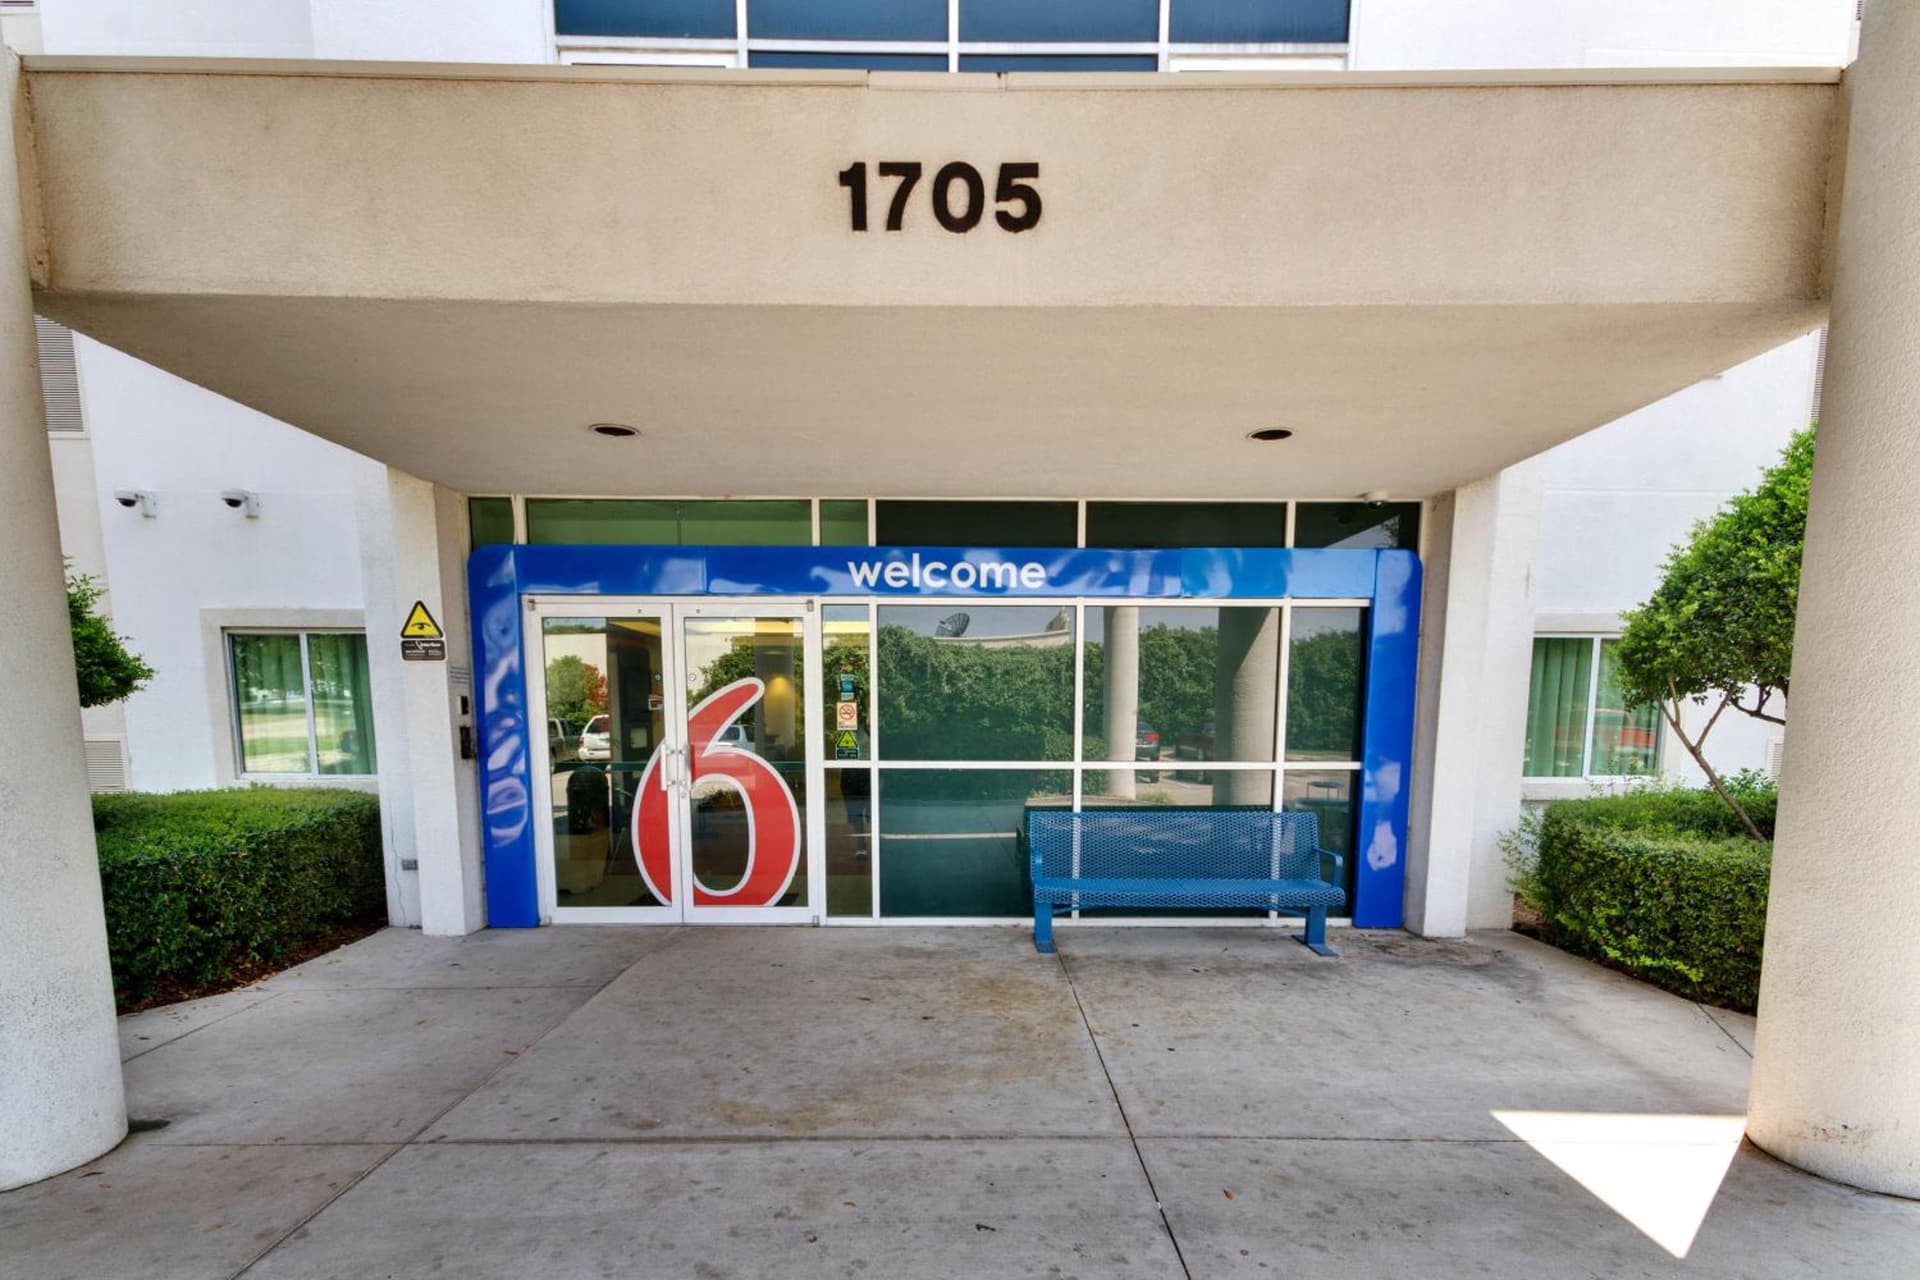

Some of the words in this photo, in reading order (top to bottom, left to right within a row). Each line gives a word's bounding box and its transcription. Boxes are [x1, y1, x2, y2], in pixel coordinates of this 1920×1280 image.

[838, 161, 1042, 233] 1705
[847, 553, 1047, 589] welcome
[632, 677, 801, 906] 6
